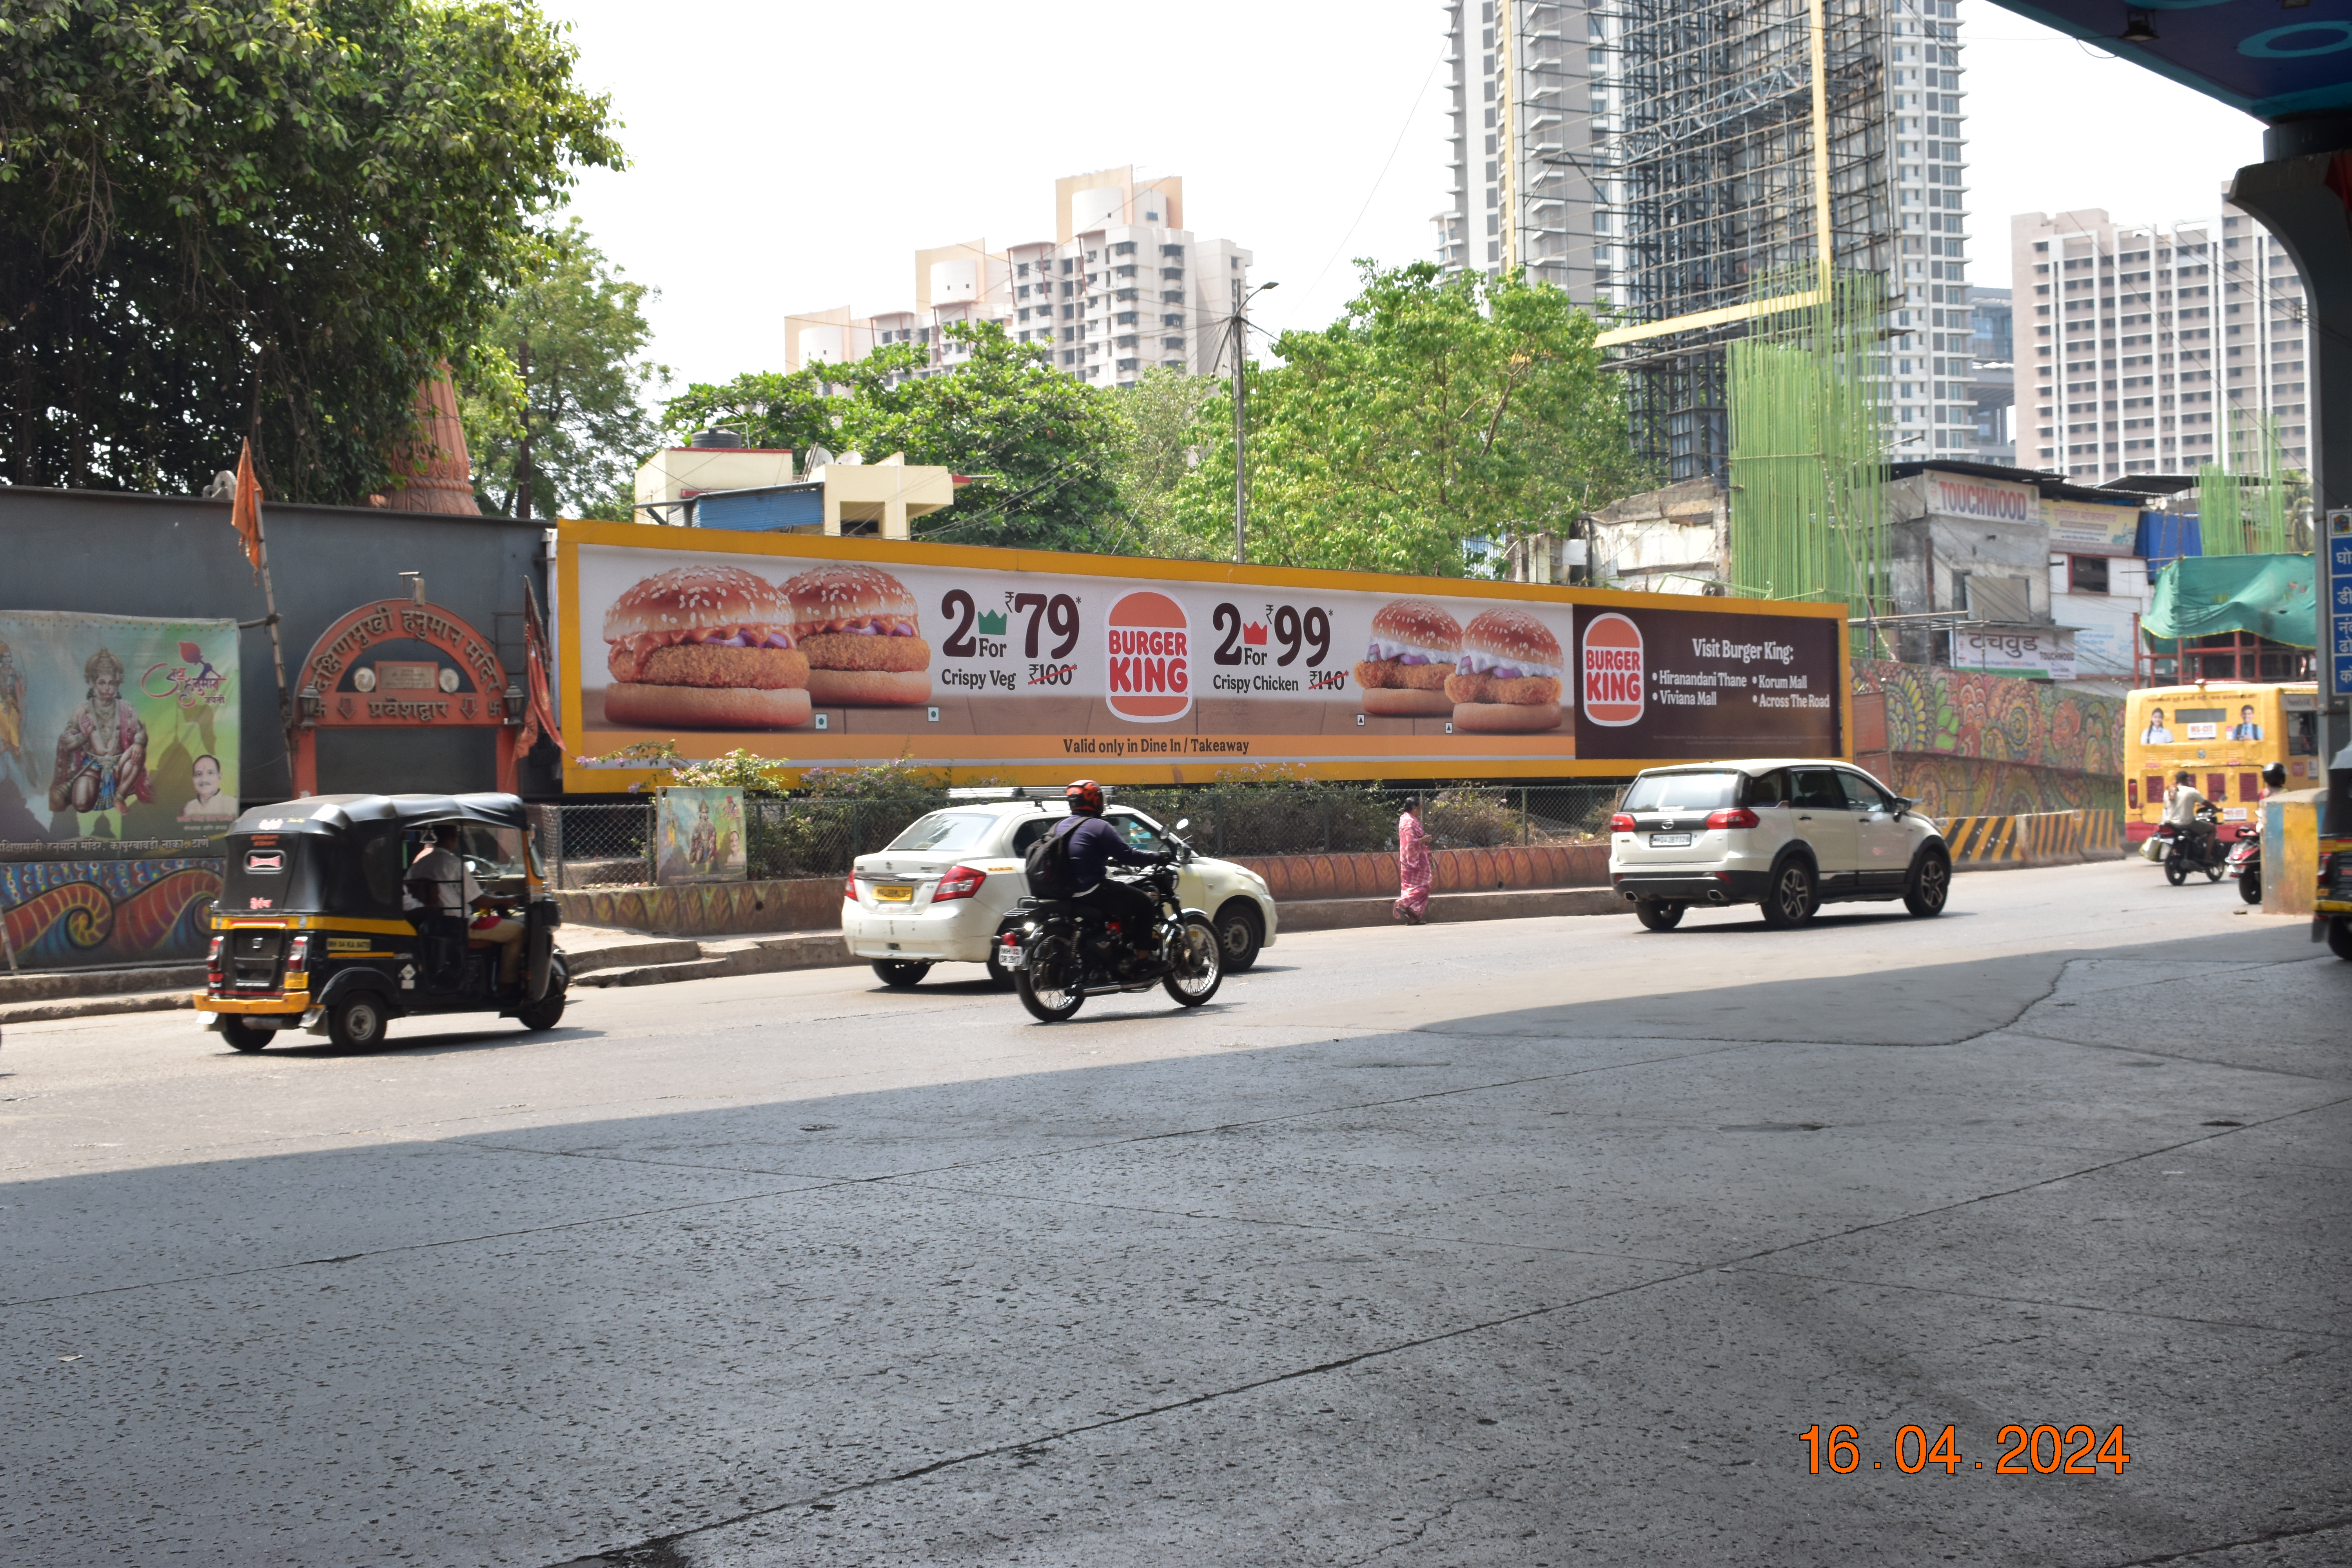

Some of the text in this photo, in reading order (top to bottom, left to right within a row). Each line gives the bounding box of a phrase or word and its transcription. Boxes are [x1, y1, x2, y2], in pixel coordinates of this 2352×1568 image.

[1939, 481, 2027, 521] TOUCHWOOD
[941, 589, 976, 657] 2
[979, 638, 1007, 657] For
[1213, 603, 1242, 665] 2
[1245, 648, 1268, 665] For
[312, 605, 502, 694] दक्षिणमुखी हनुमान मंदिर
[1109, 630, 1187, 656] BURGER
[1692, 638, 1794, 664] Visit Burger King:
[1586, 650, 1641, 671] BURGER
[942, 668, 986, 690] Crispy
[990, 670, 1016, 690] Veg
[1109, 657, 1188, 693] KING
[1213, 675, 1251, 693] Crispy
[1253, 675, 1299, 691] Chicken
[1586, 672, 1641, 701] KING
[1659, 670, 1747, 687] Hiranandani Thane
[1759, 675, 1807, 689] Korum Mall
[368, 697, 449, 720] प्रवेशद्वार
[1659, 690, 1717, 706] Viviana Mall
[1759, 693, 1830, 708] Across The Road
[1063, 739, 1095, 753] Valid
[1099, 739, 1124, 756] only
[1127, 739, 1138, 752] in
[1141, 739, 1167, 752] Dine
[1170, 739, 1181, 752] In
[1191, 739, 1249, 755] Takeaway
